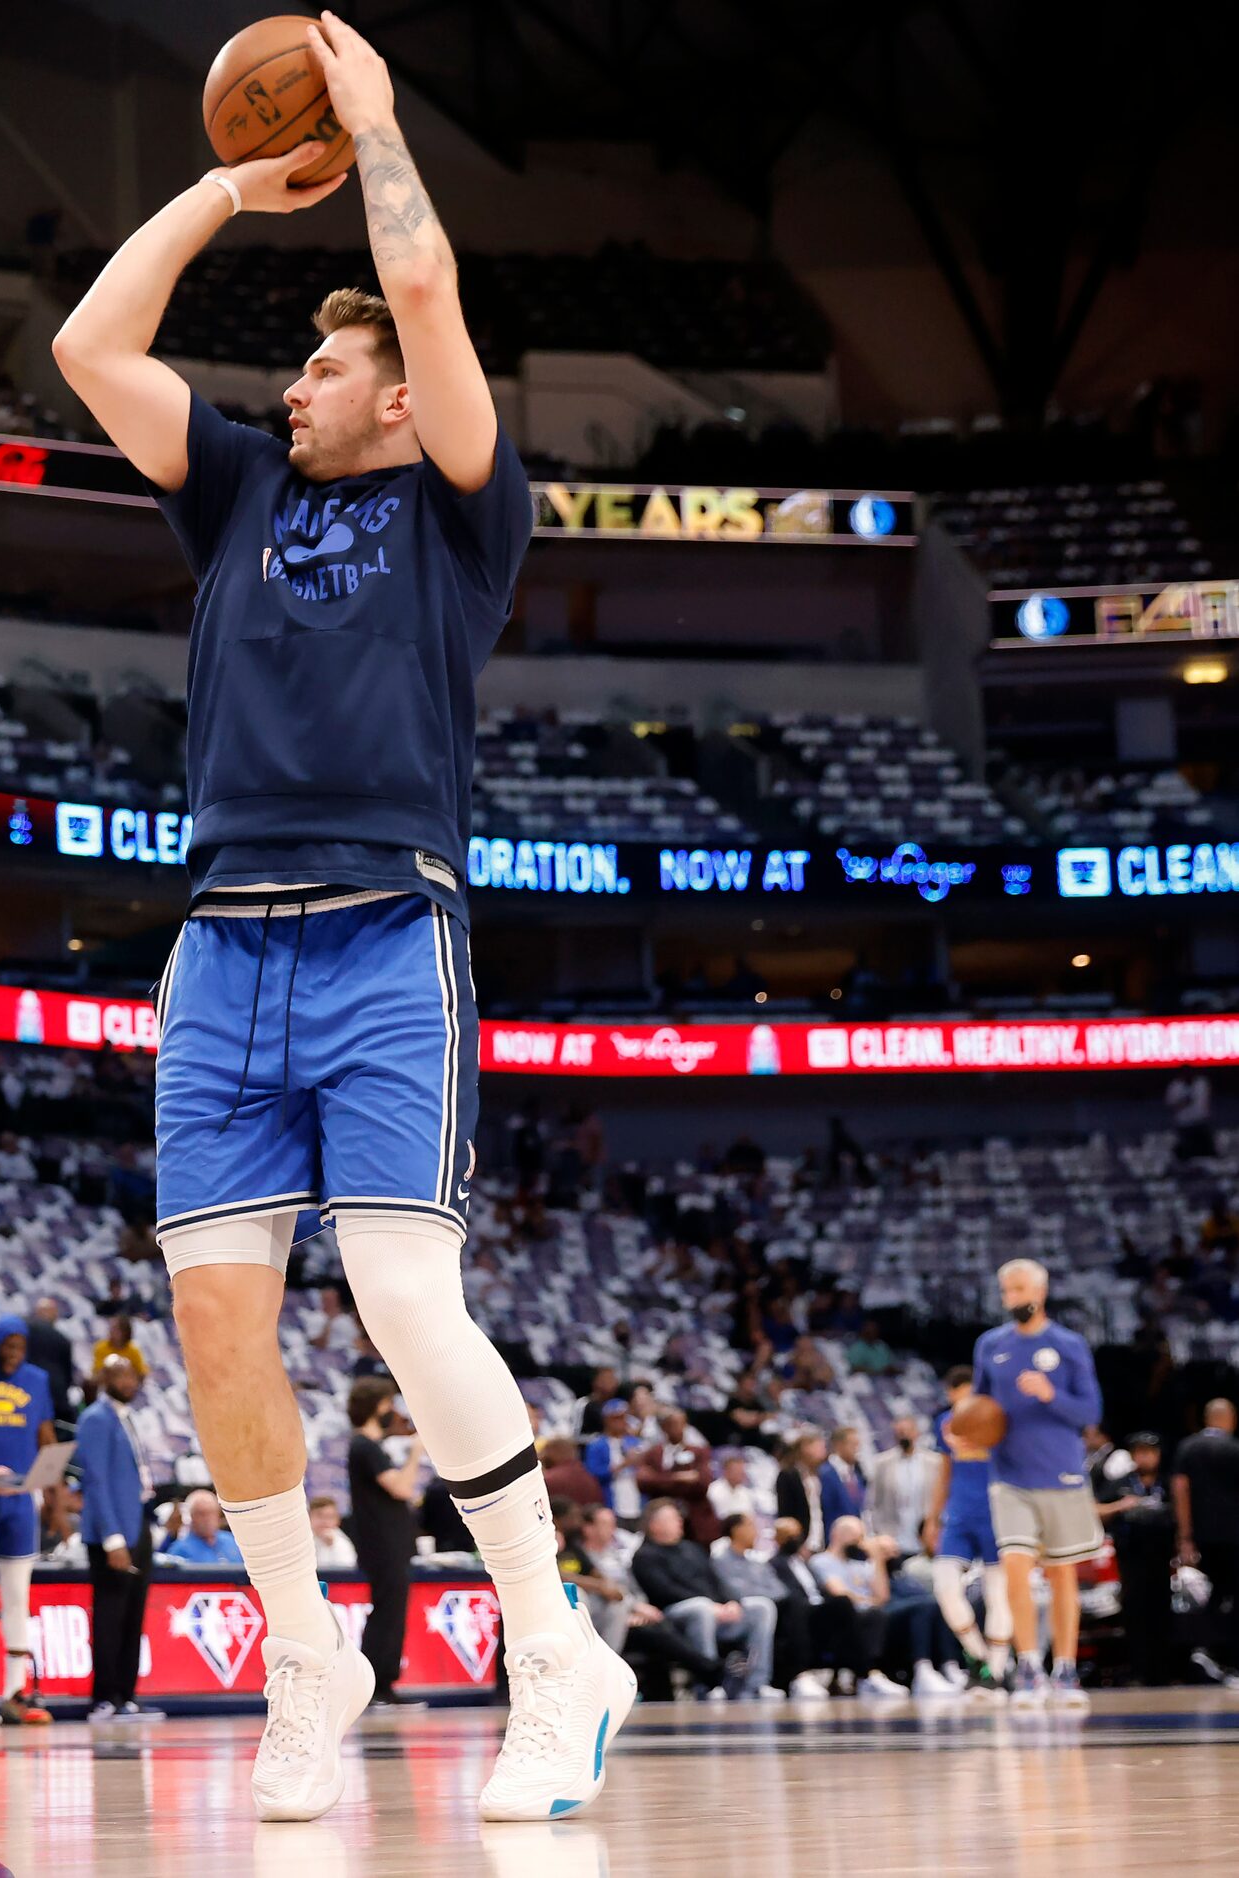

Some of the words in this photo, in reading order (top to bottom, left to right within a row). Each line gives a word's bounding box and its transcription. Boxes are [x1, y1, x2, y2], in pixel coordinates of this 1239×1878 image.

[545, 483, 763, 540] YEARS
[659, 849, 752, 892] NOW
[762, 849, 811, 892] AT
[492, 1030, 556, 1065] NOW
[560, 1033, 596, 1066] AT
[850, 1028, 953, 1067] CLEAN.
[952, 1025, 1085, 1066] HEALTHY.
